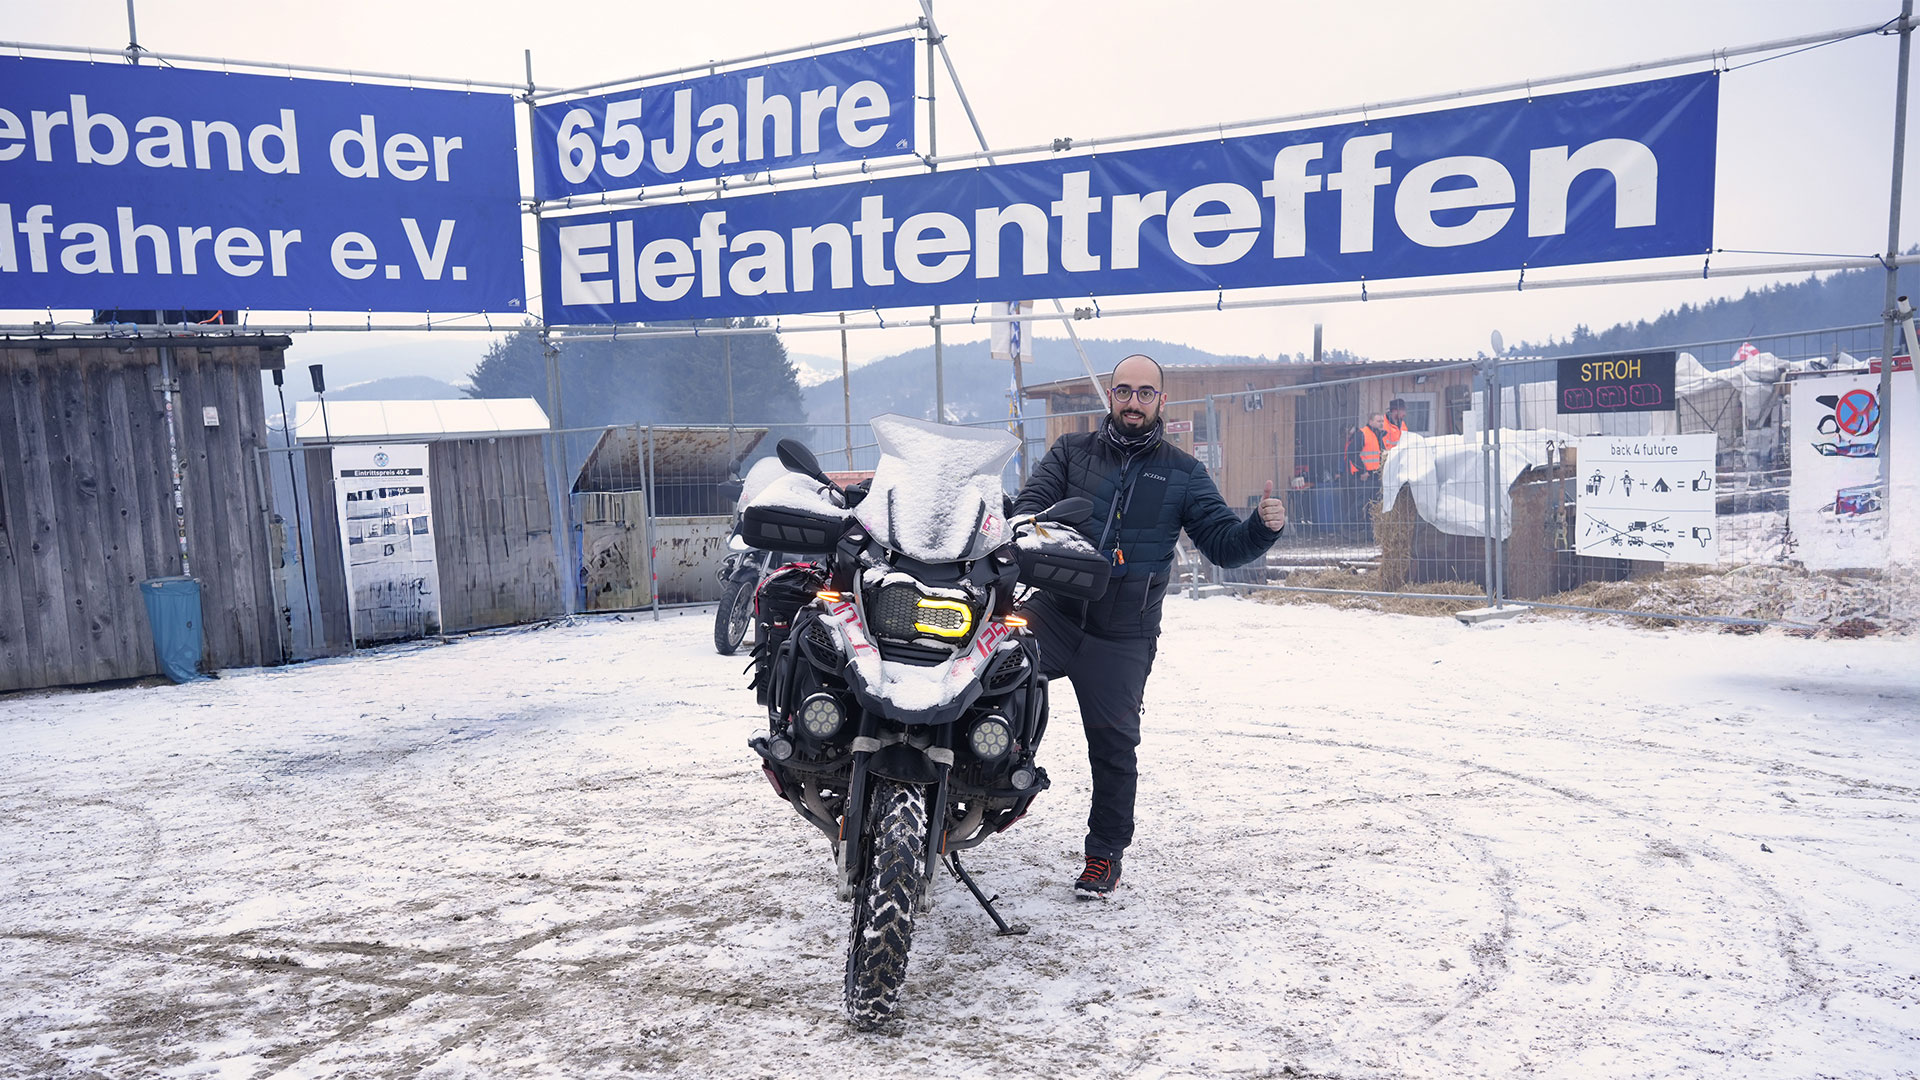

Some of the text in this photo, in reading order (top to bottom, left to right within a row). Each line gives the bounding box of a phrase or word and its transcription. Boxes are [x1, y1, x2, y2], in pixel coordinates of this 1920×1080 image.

[330, 115, 462, 181] der
[559, 132, 1658, 306] Elefantentreffen
[331, 218, 466, 280] e.V.
[1581, 359, 1641, 382] STROH
[1610, 443, 1678, 456] back 4 future
[354, 469, 395, 477] Eintrittspreis
